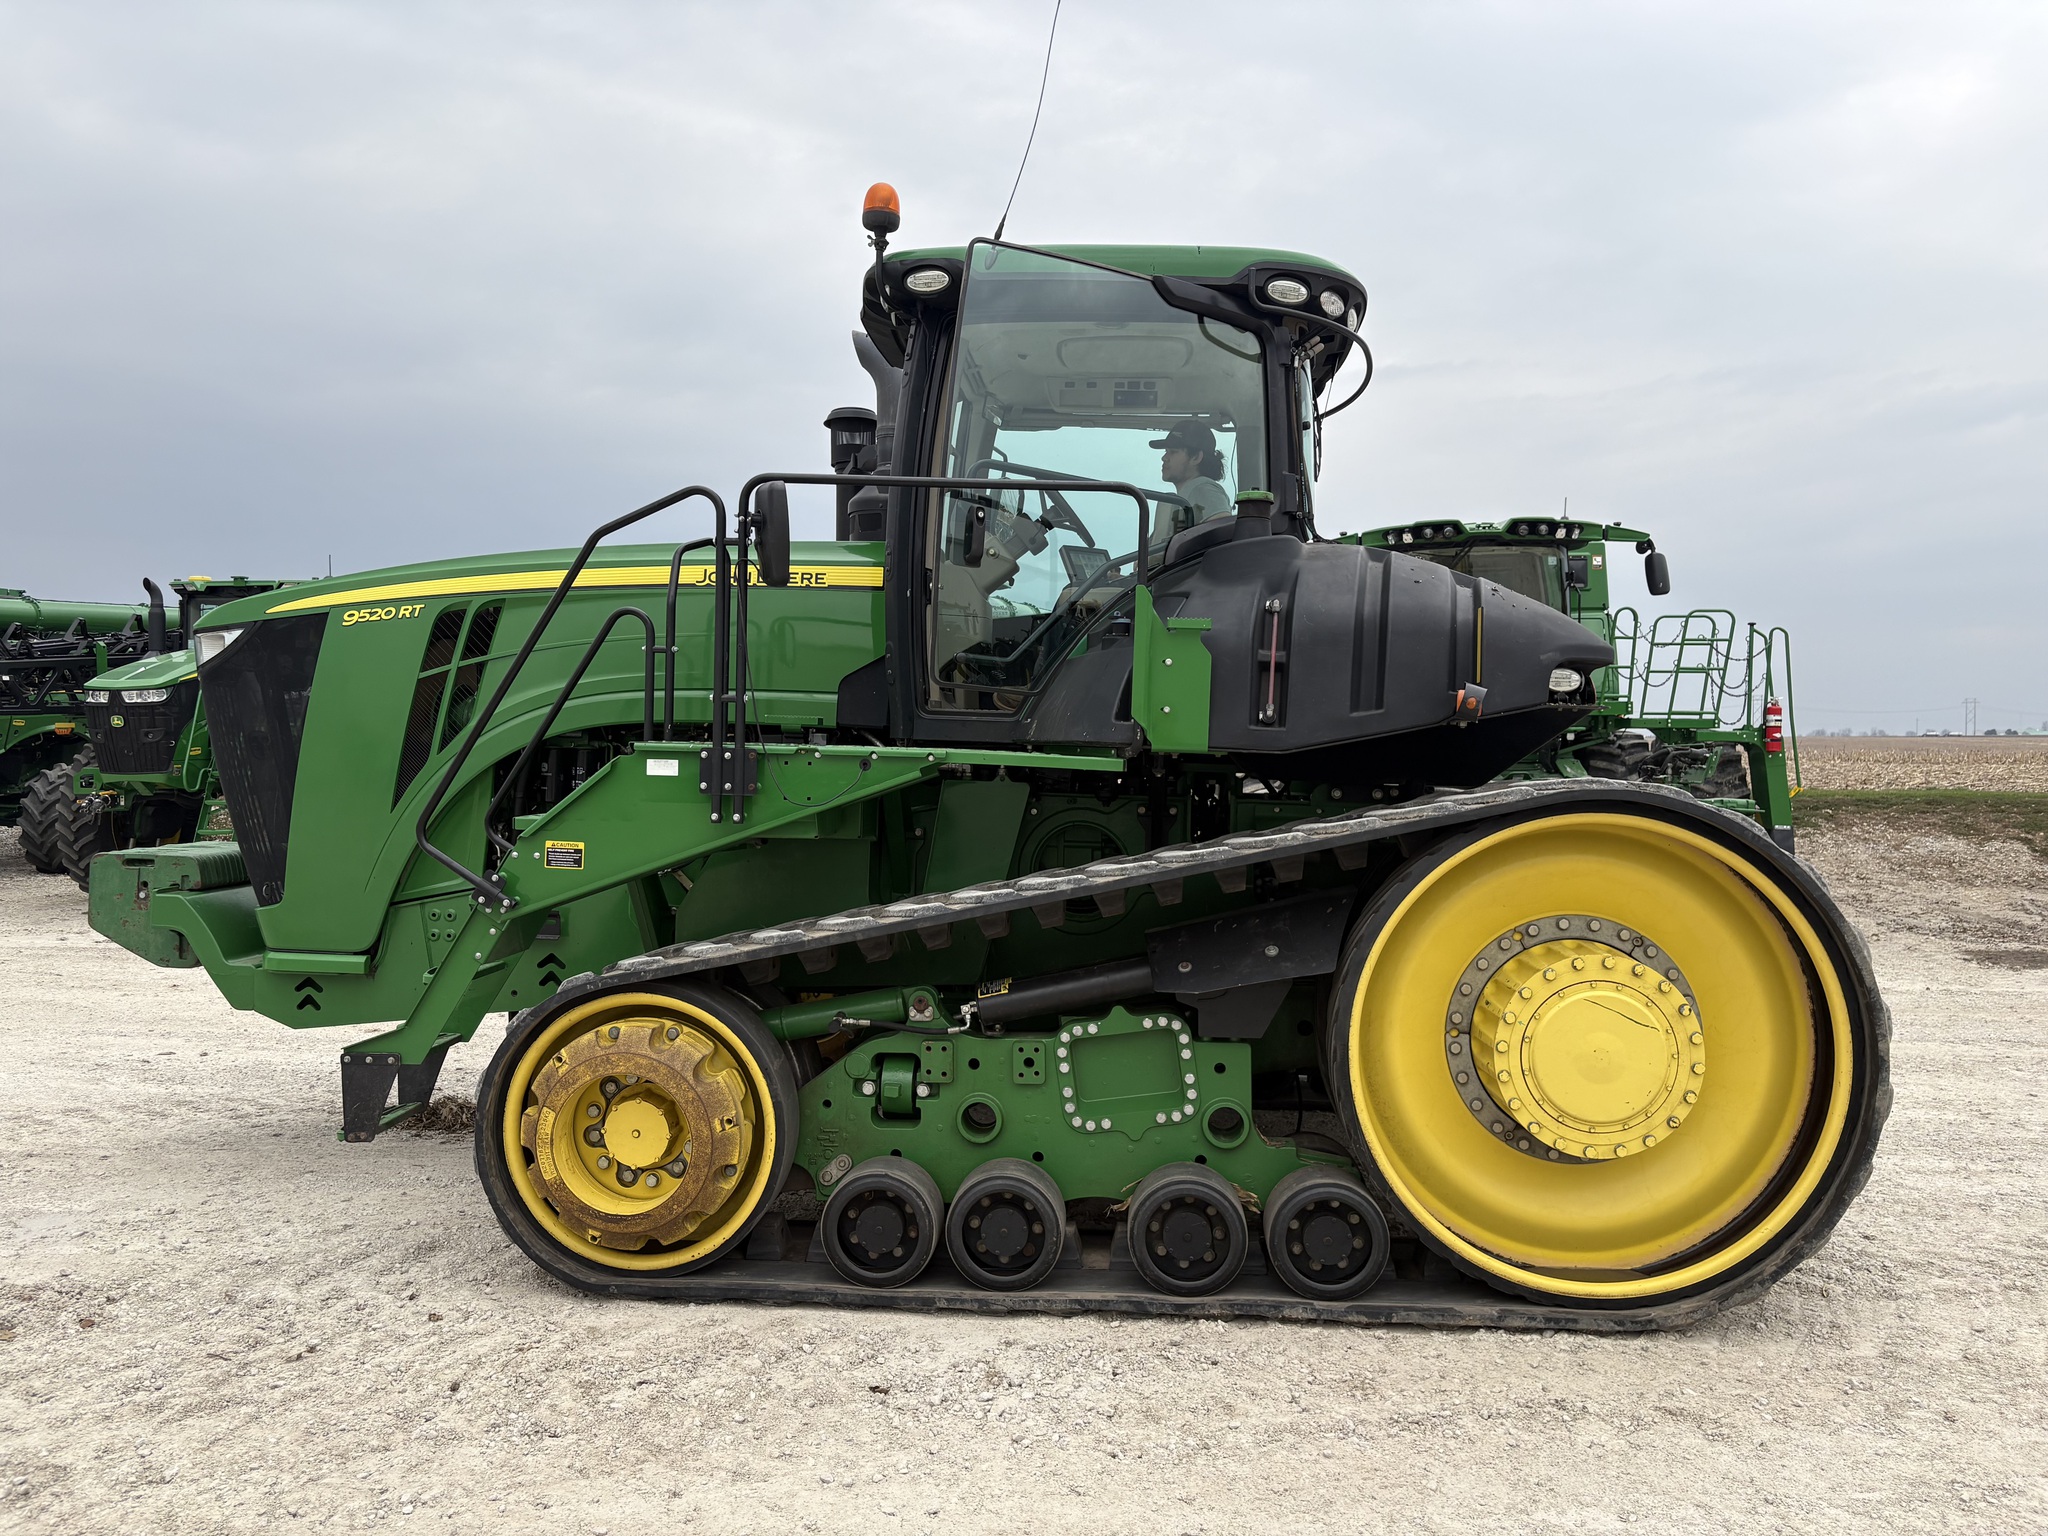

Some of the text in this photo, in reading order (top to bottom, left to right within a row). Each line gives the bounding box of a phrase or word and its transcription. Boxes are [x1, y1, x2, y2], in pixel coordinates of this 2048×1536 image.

[757, 571, 827, 585] ERE
[342, 604, 425, 626] 9520 RT
